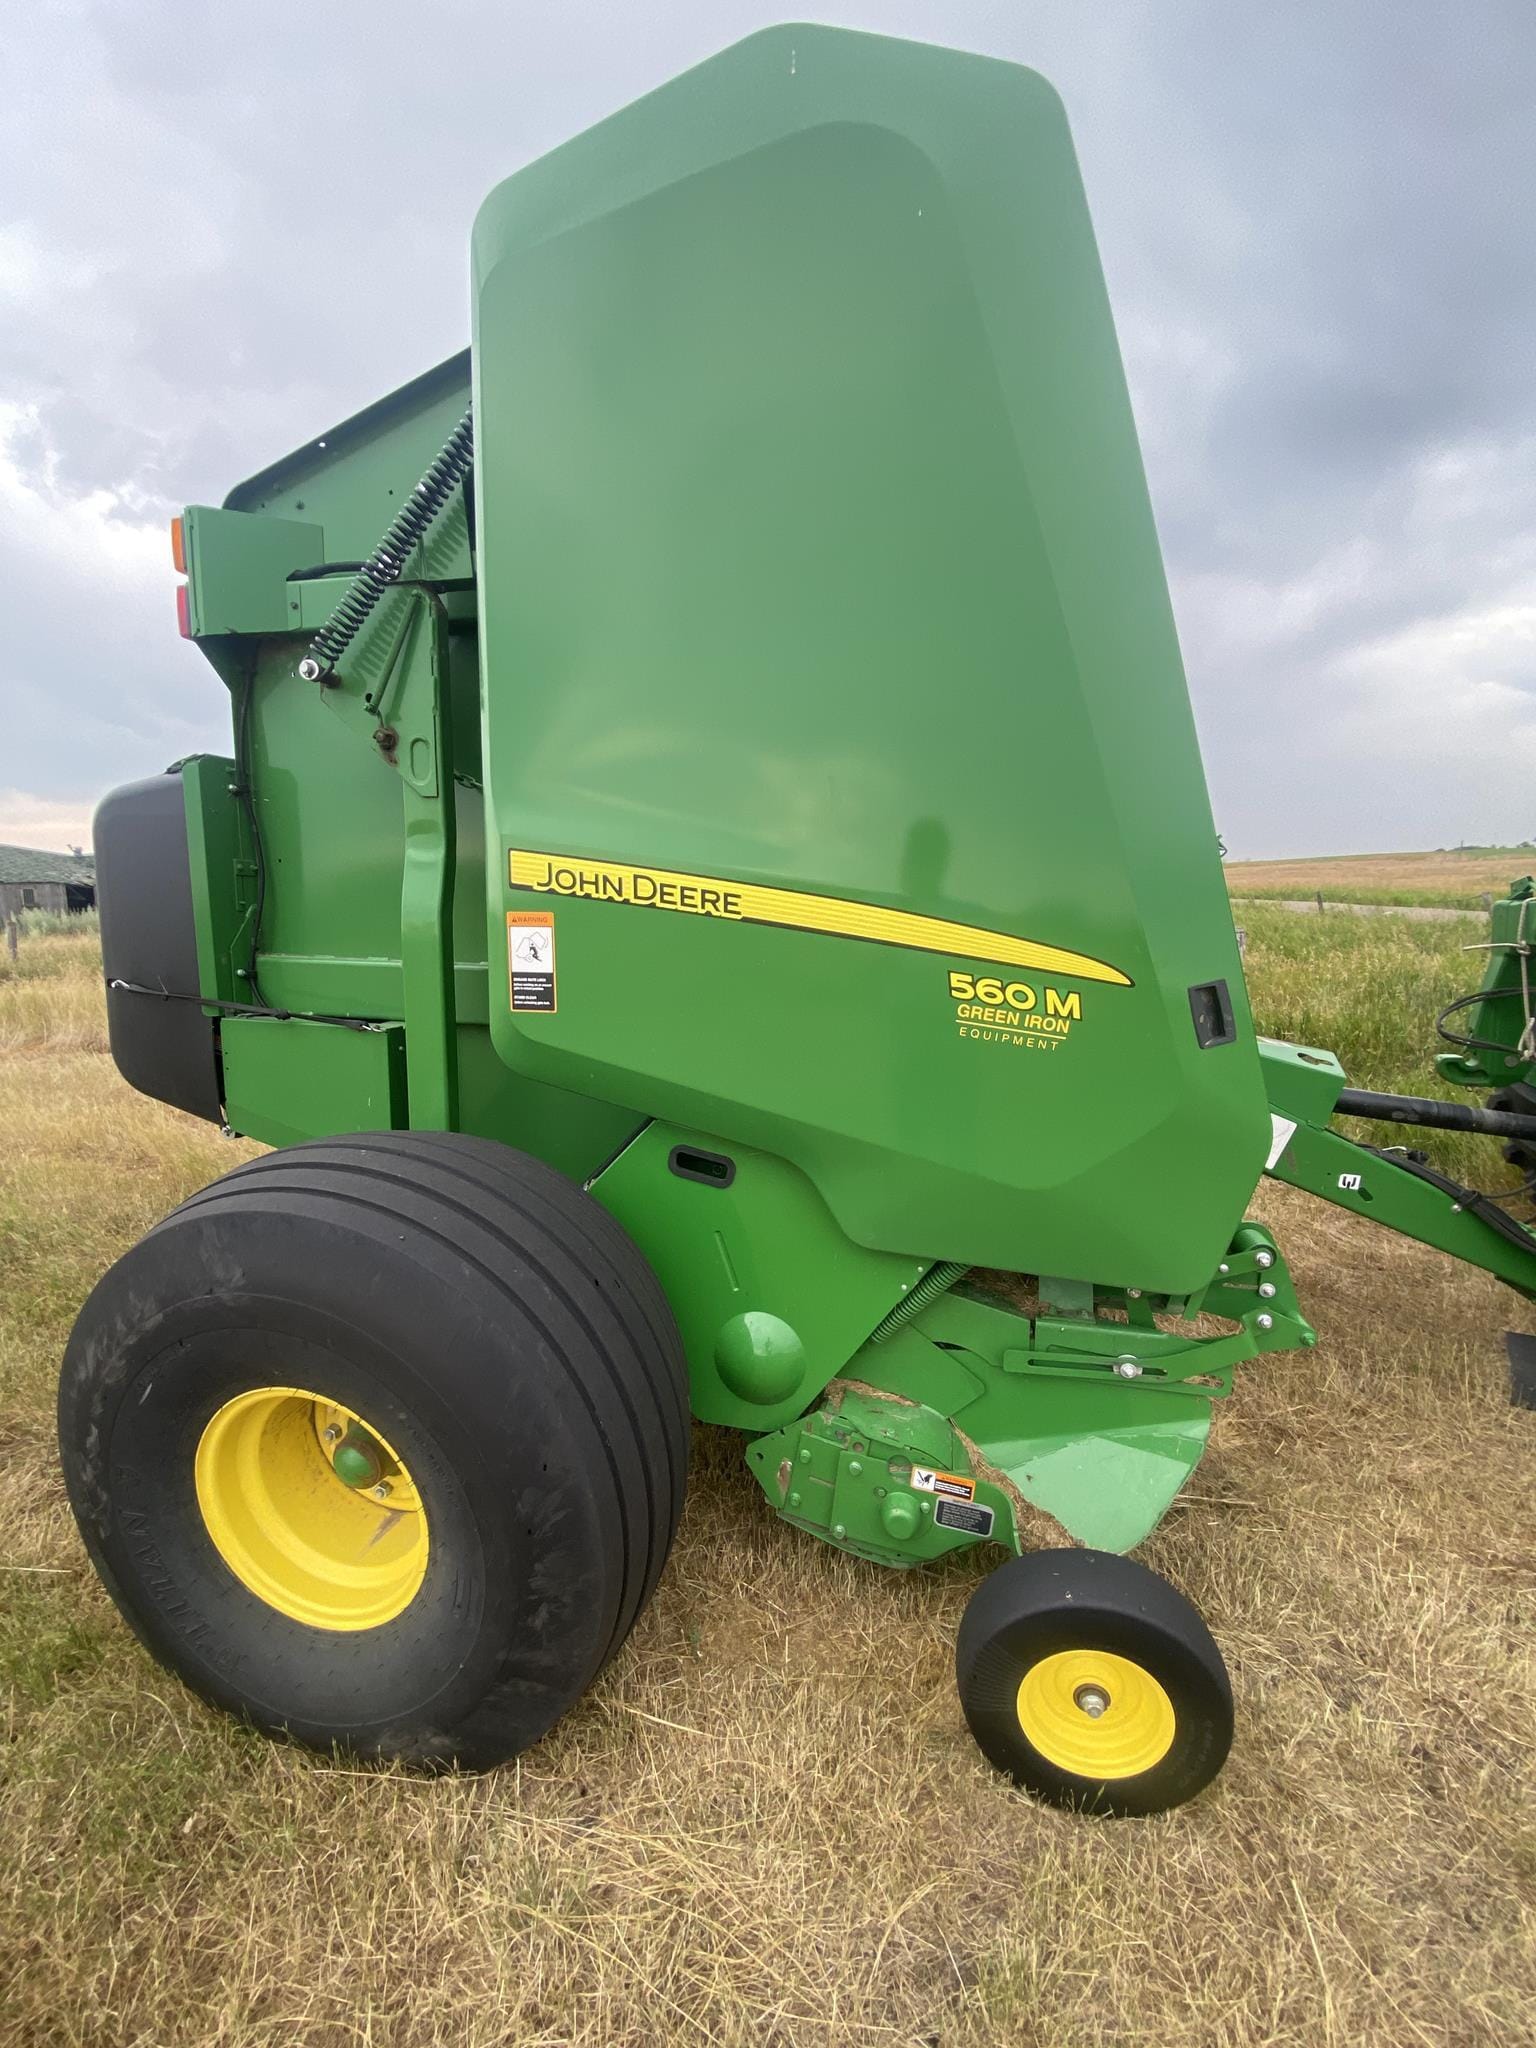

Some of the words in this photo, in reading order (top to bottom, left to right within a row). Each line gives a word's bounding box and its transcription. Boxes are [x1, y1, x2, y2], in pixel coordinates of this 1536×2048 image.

[536, 862, 623, 898] JOHN
[633, 874, 742, 915] DEERE
[949, 971, 1036, 1010] 560
[1045, 988, 1082, 1020] M
[957, 1003, 1020, 1026] GREEN
[1024, 1014, 1070, 1034] IRON
[959, 1026, 1059, 1051] EQUIPMENT
